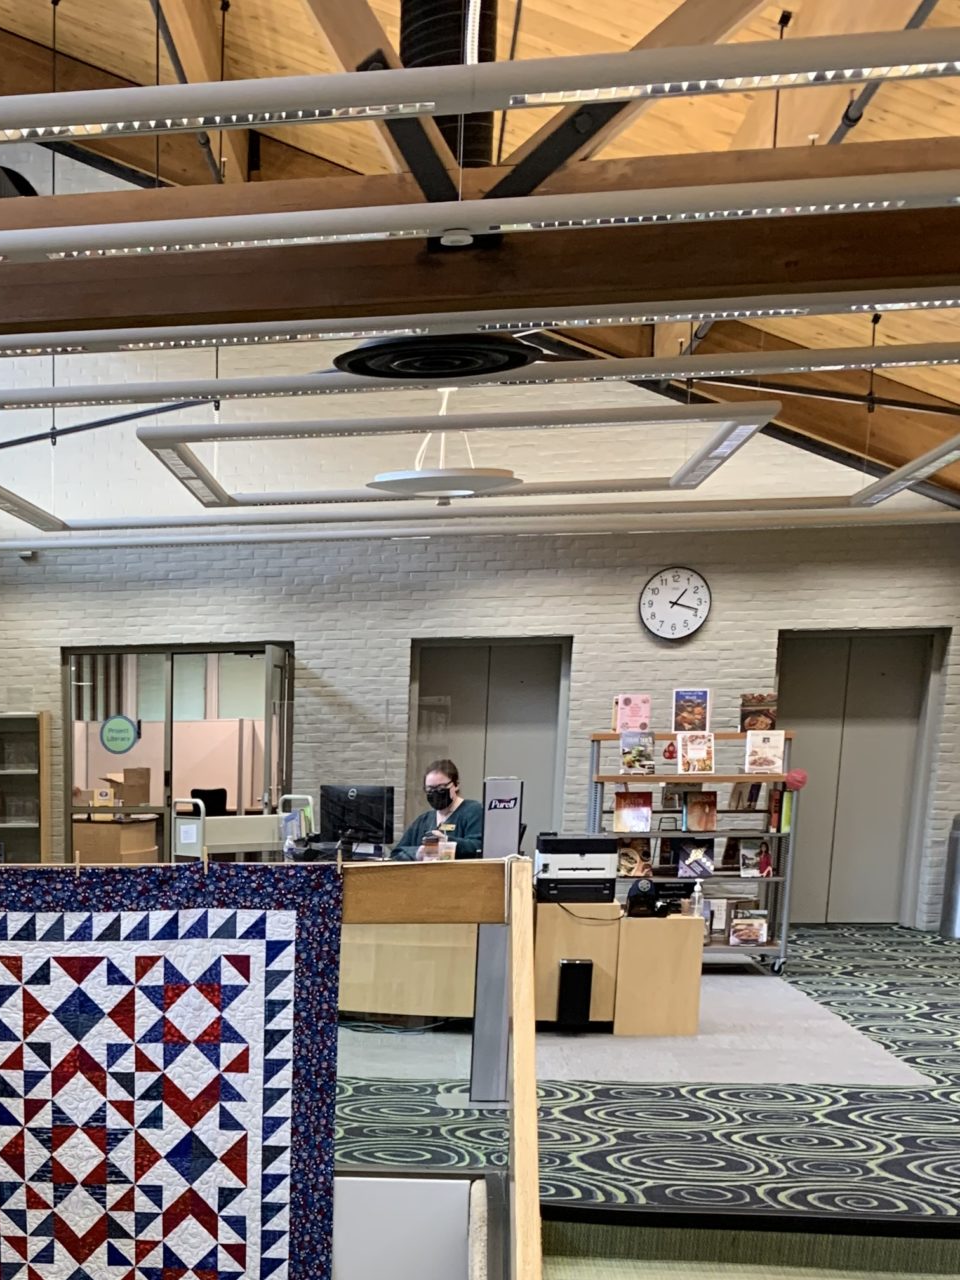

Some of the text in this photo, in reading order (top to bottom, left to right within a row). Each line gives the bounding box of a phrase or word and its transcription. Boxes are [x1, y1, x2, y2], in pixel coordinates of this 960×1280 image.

[660, 578, 668, 586] 11
[672, 574, 681, 583] 12
[686, 577, 691, 585] 1
[651, 587, 660, 596] 10
[693, 585, 700, 594] 2
[647, 600, 654, 608] 9
[696, 597, 703, 607] 3
[650, 612, 656, 620] 8
[659, 620, 665, 628] 7
[670, 623, 677, 631] 6
[683, 619, 689, 628] 5
